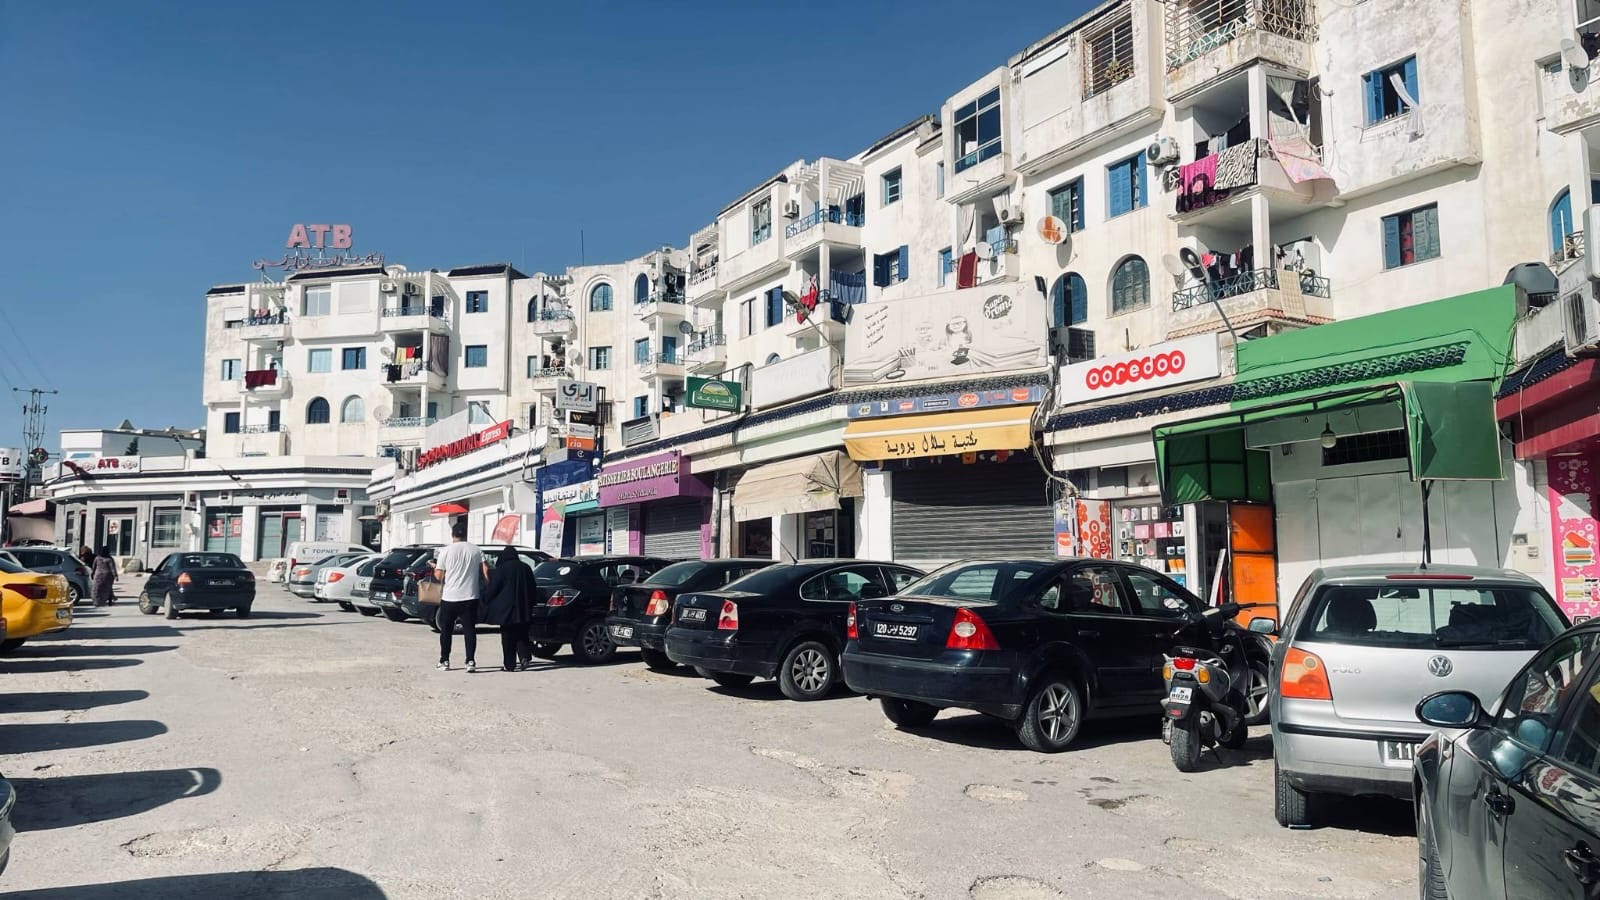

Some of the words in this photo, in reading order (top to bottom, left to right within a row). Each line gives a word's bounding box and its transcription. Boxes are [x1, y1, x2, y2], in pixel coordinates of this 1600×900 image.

[286, 223, 352, 249] ATB
[1086, 351, 1184, 389] ooredoo
[482, 427, 502, 444] Express
[569, 440, 582, 448] ria
[922, 433, 945, 453] بلال
[952, 431, 978, 450] مكتبة
[97, 458, 119, 469] ATB
[877, 623, 887, 634] 120
[899, 625, 917, 637] 5297
